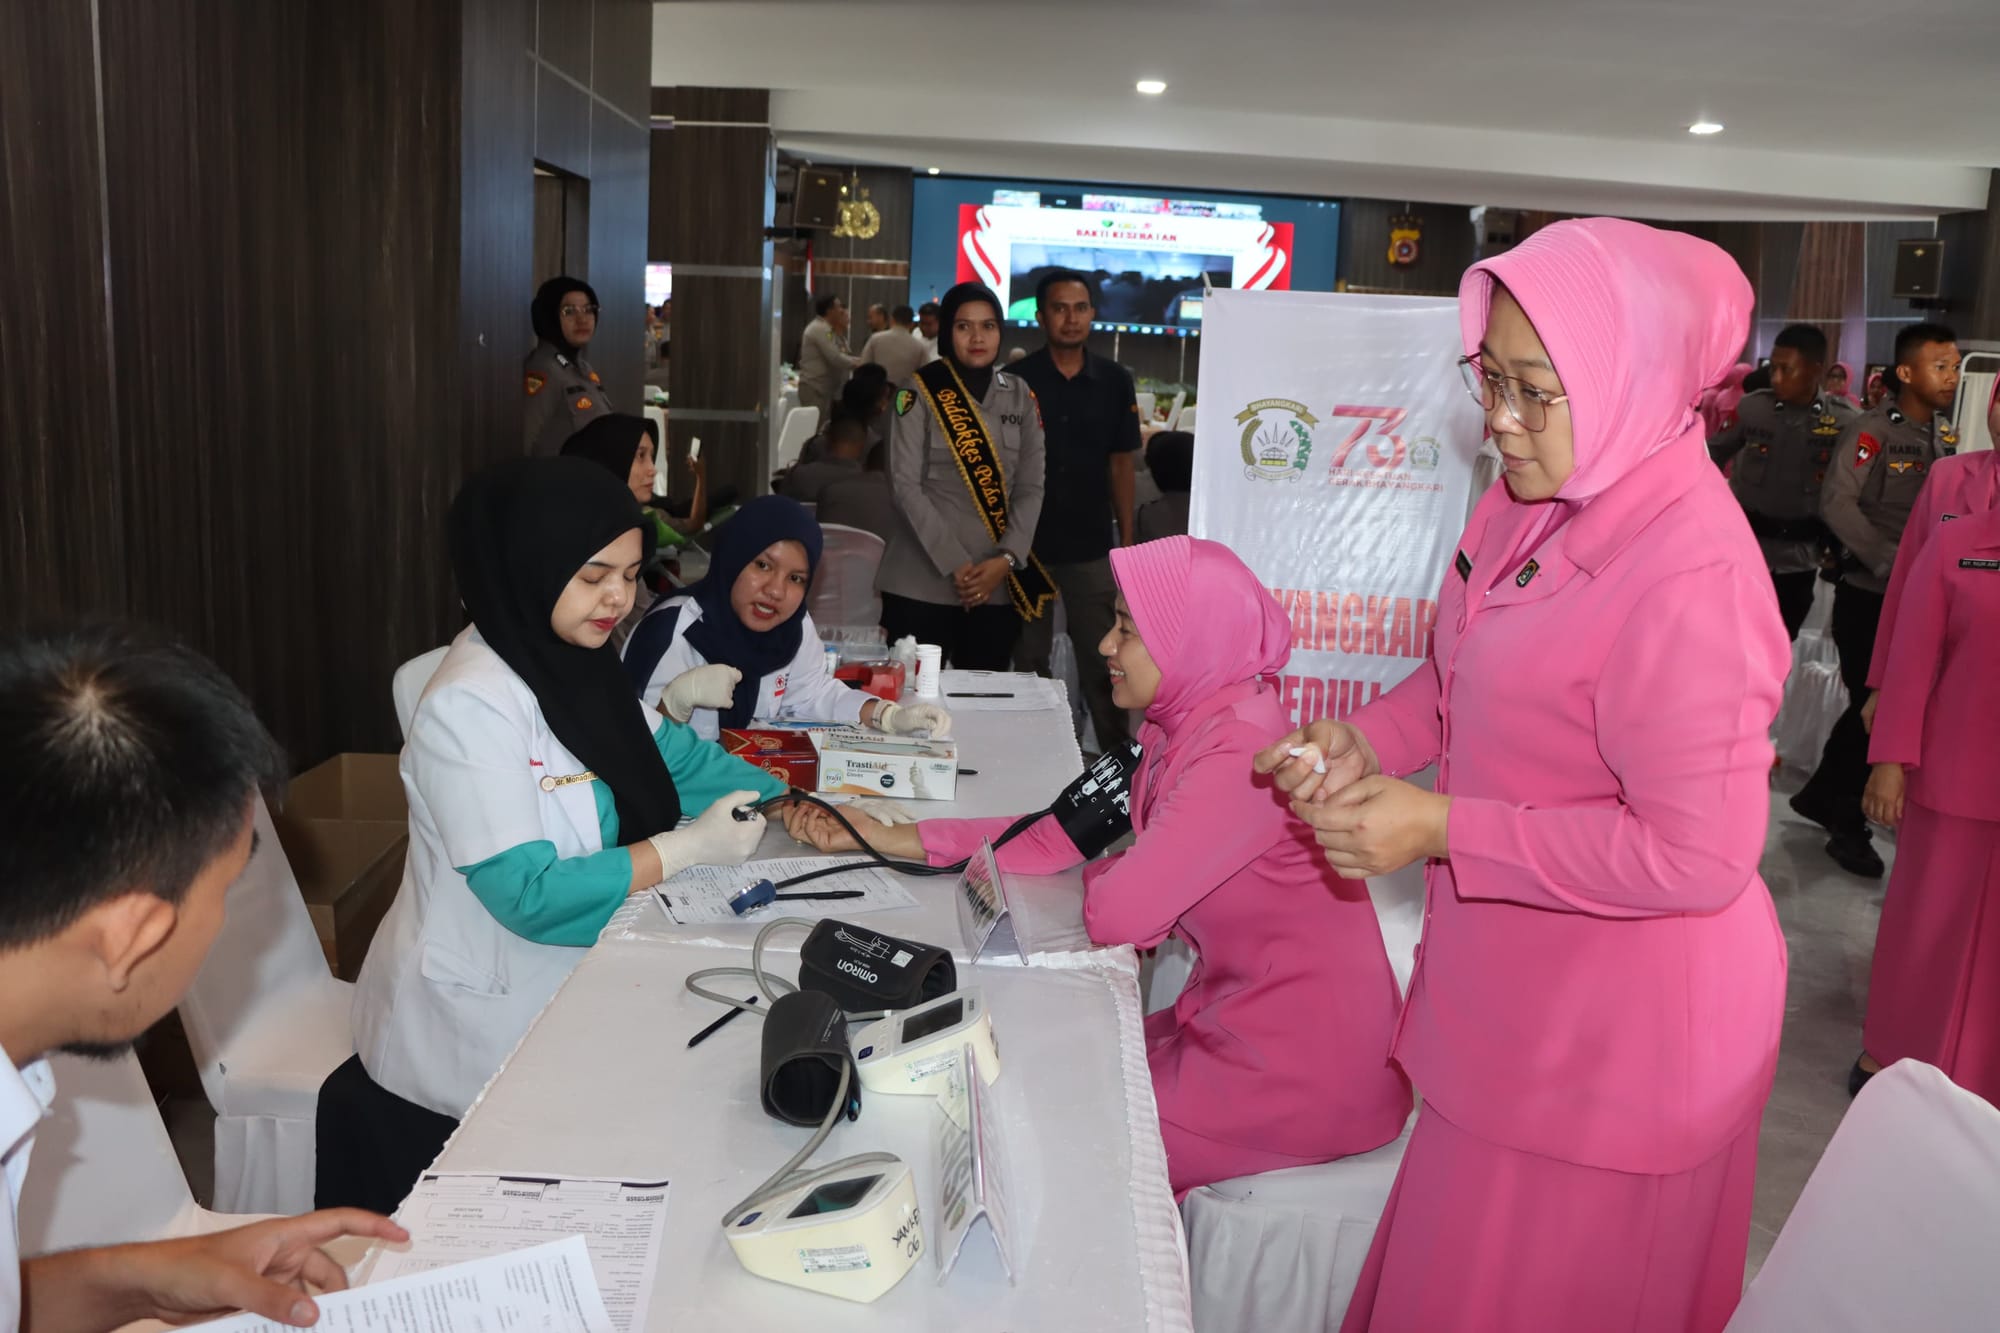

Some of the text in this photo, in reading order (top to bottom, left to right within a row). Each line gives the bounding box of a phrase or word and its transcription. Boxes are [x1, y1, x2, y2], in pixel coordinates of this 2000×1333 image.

[936, 388, 983, 464] Biddokkes
[1329, 404, 1408, 470] 73
[1364, 480, 1444, 492] BHAYANGKARI
[846, 759, 888, 770] TrastiAid
[837, 958, 878, 984] OMRON
